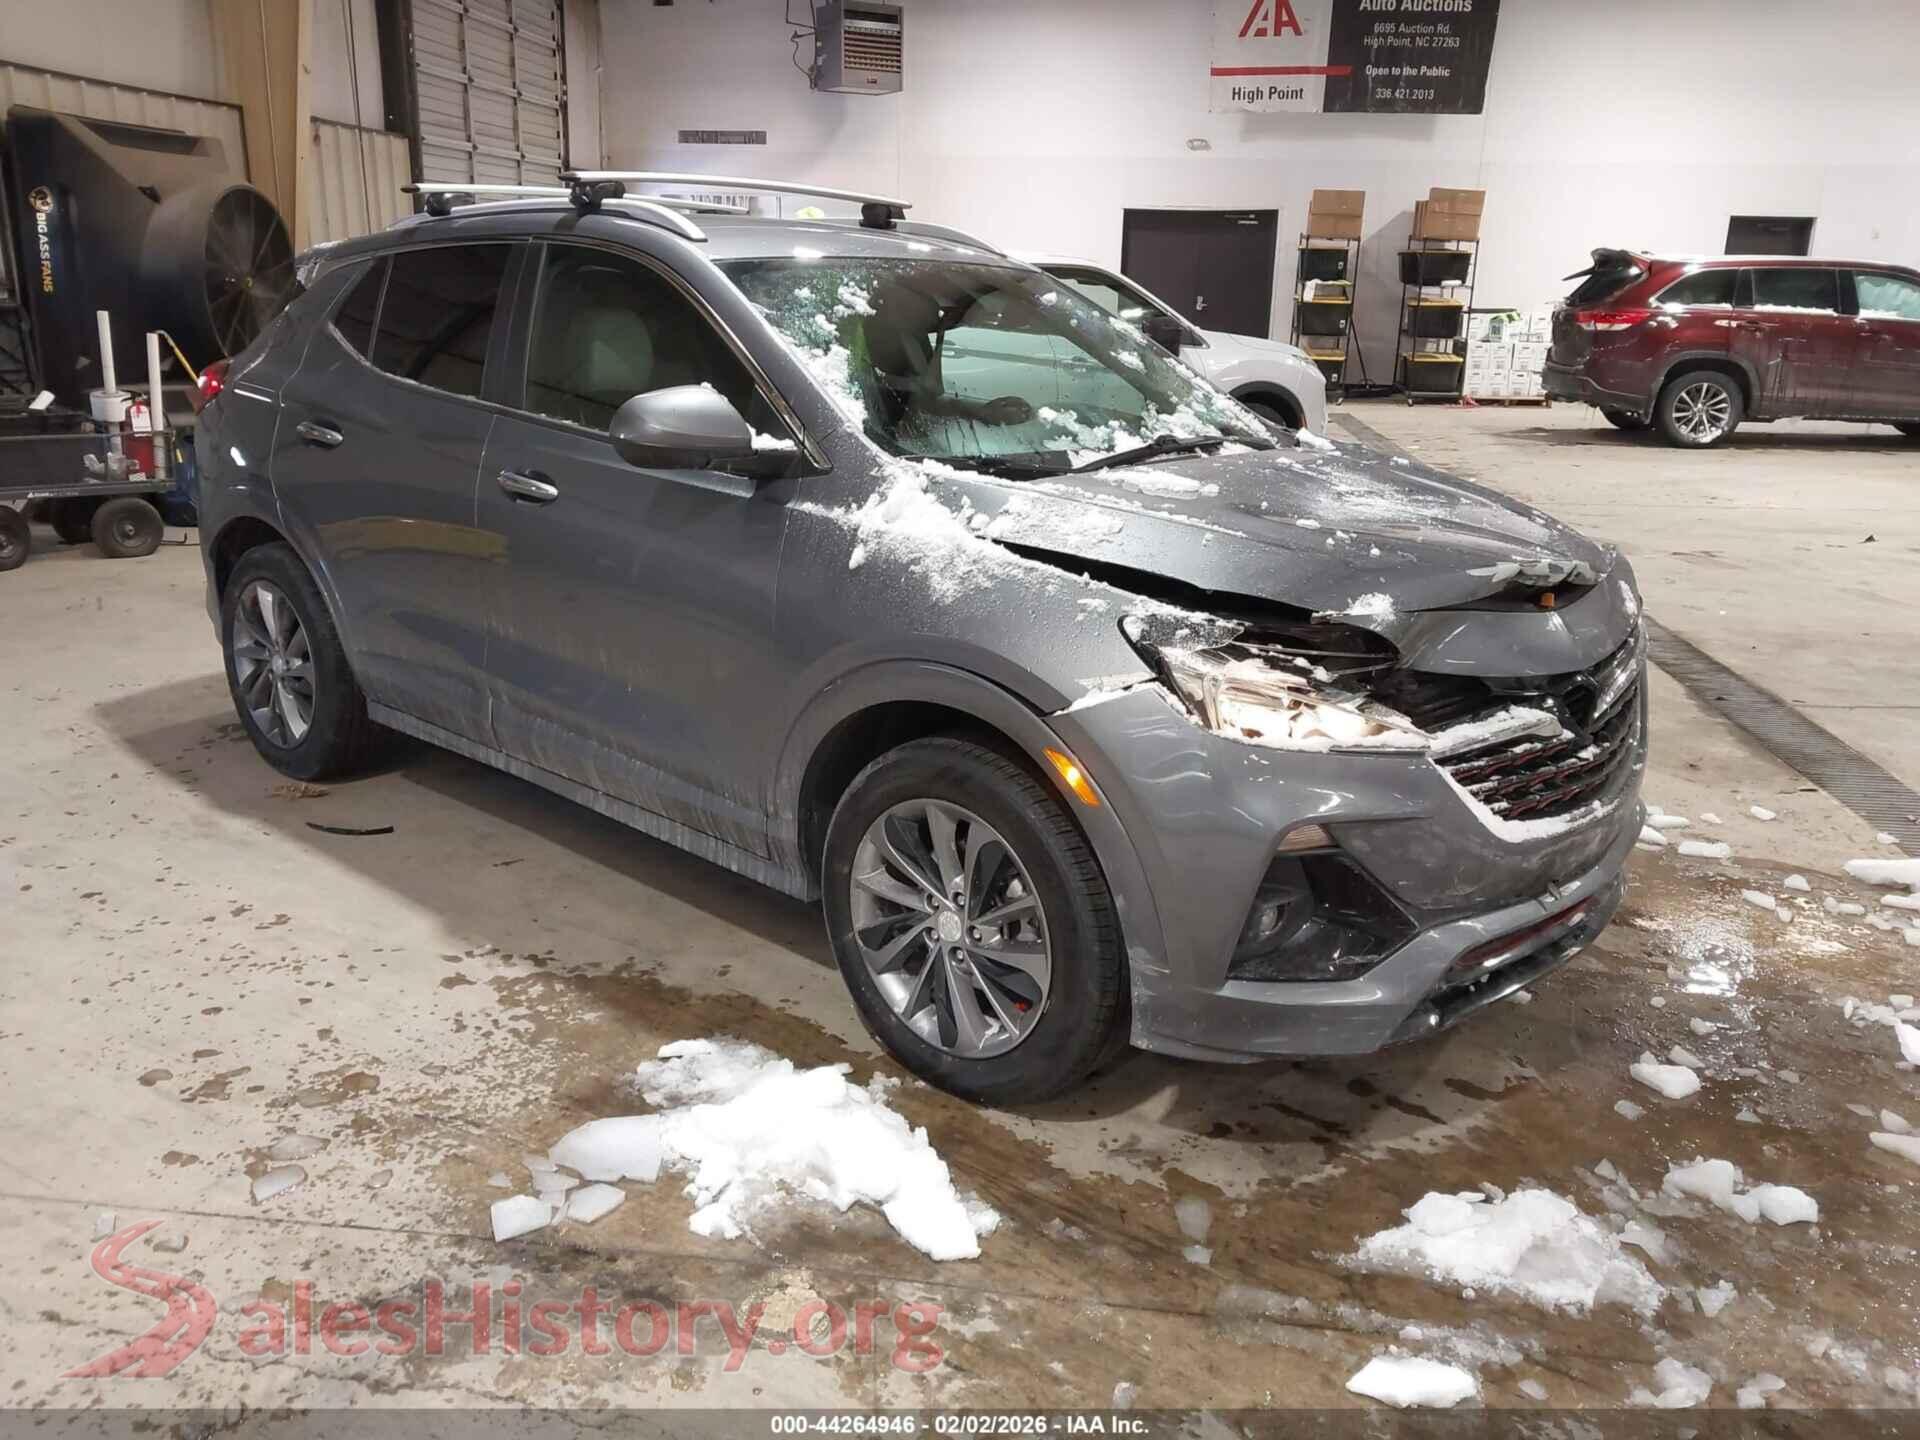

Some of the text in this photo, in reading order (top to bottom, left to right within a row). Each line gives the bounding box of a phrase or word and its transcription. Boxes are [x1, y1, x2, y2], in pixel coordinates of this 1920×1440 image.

[1359, 0, 1473, 13] Auto Auctions
[1374, 22, 1396, 34] 6695
[1398, 23, 1435, 34] Auction
[1363, 35, 1385, 48] High
[1415, 36, 1430, 47] NC
[1432, 36, 1460, 48] 27263
[1365, 64, 1451, 77] Open to the Public
[1231, 86, 1304, 104] High Point
[36, 212, 53, 292] BIG ASS FANS
